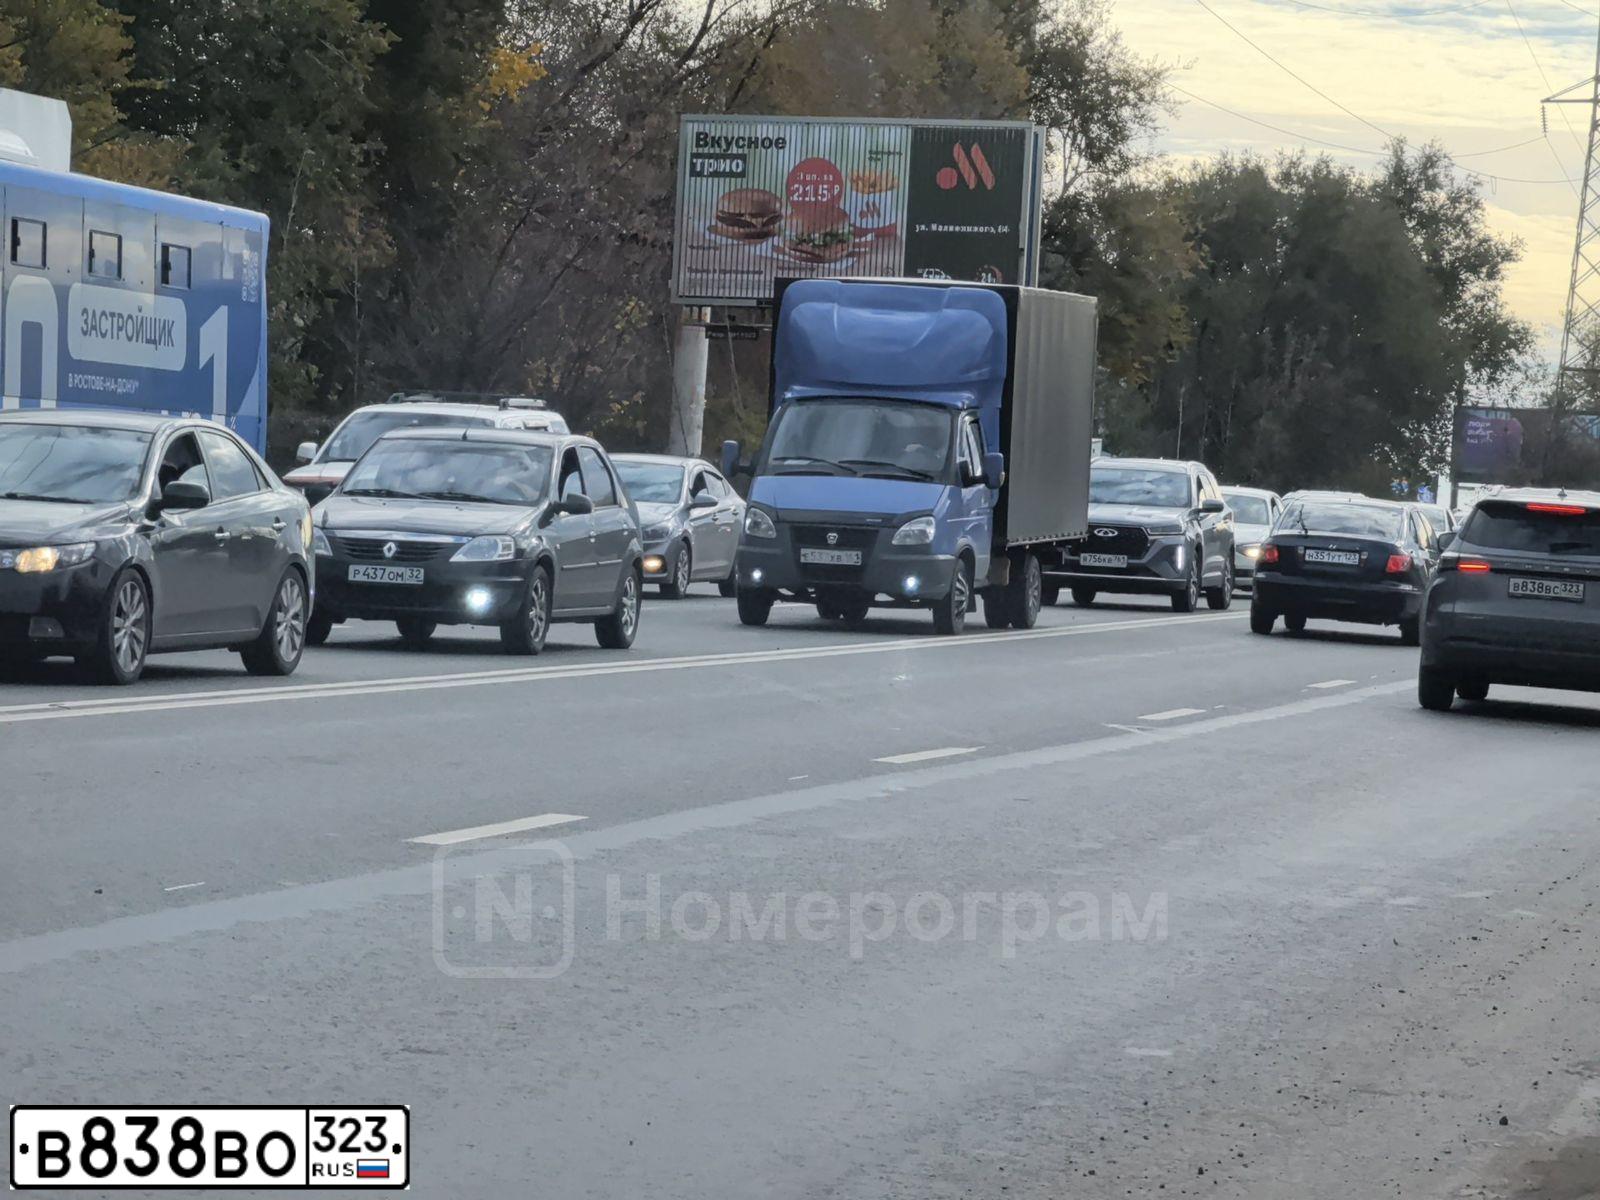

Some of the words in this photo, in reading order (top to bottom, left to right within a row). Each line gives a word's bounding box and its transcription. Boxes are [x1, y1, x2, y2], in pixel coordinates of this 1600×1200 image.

[694, 131, 787, 152] Вкусное
[692, 158, 744, 176] трио
[789, 183, 831, 202] 215
[80, 307, 175, 350] ЗАСТРОЙЩИК
